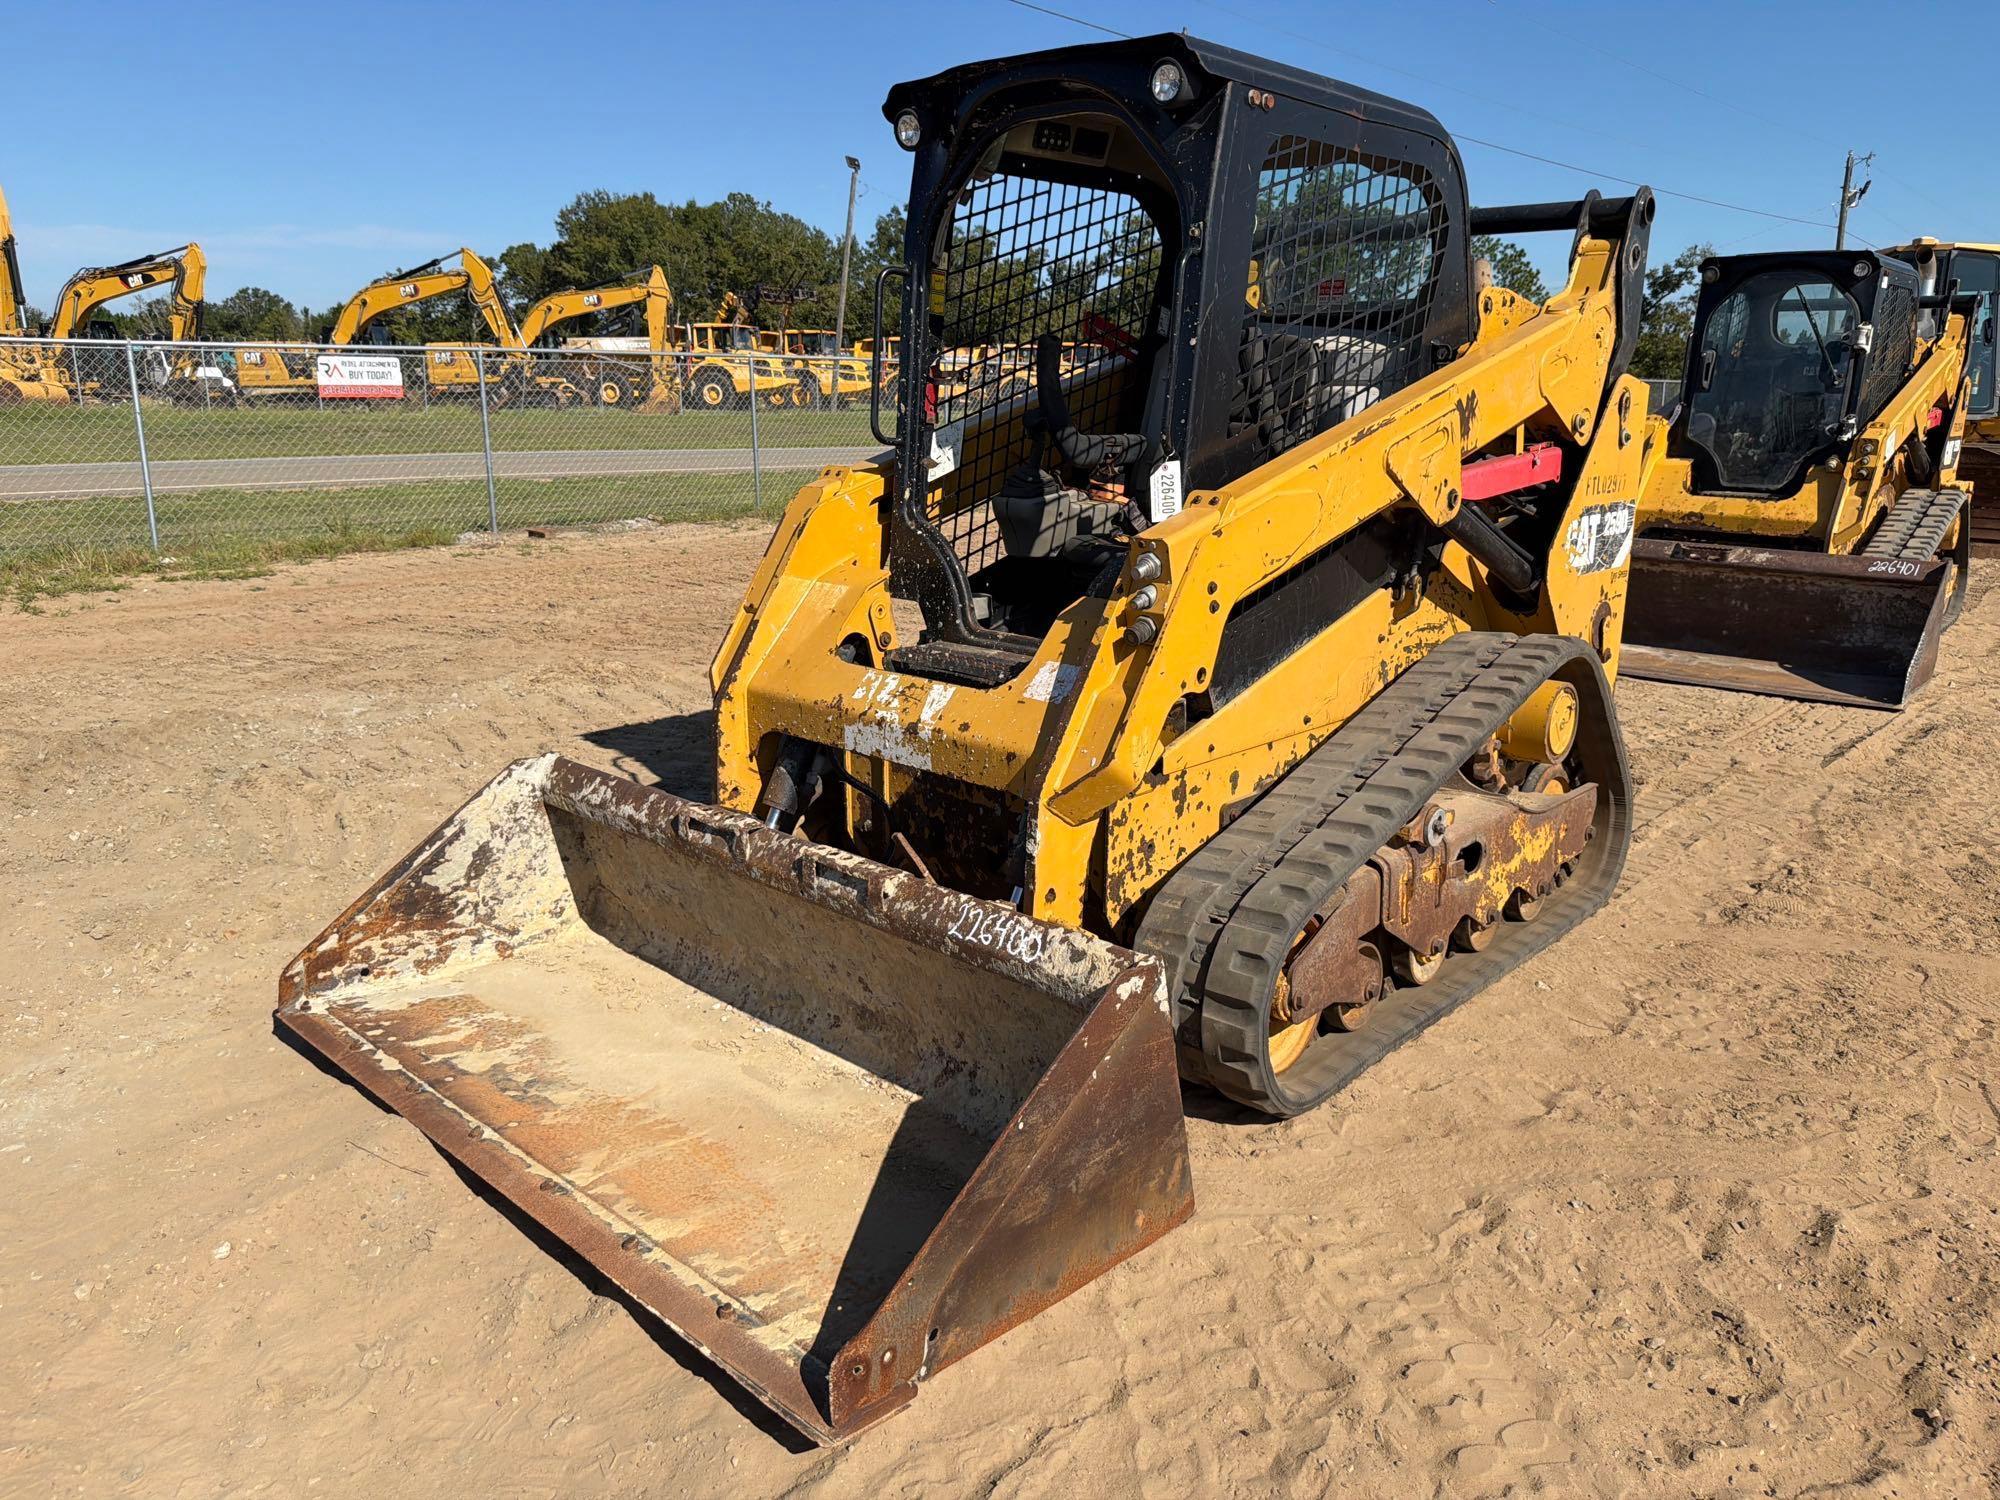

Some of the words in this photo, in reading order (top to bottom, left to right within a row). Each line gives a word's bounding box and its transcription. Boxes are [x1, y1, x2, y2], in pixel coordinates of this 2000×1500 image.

[128, 273, 144, 288] CAT
[400, 284, 415, 297] CAT
[584, 294, 598, 305] CAT
[244, 352, 261, 364] CAT
[435, 351, 451, 364] CAT
[359, 360, 398, 369] ATTACHMENTS
[348, 370, 364, 380] BUY
[366, 370, 393, 380] TODAY!
[1161, 473, 1176, 515] 226400
[1867, 560, 1921, 577] 226401
[947, 902, 1043, 964] 226400
